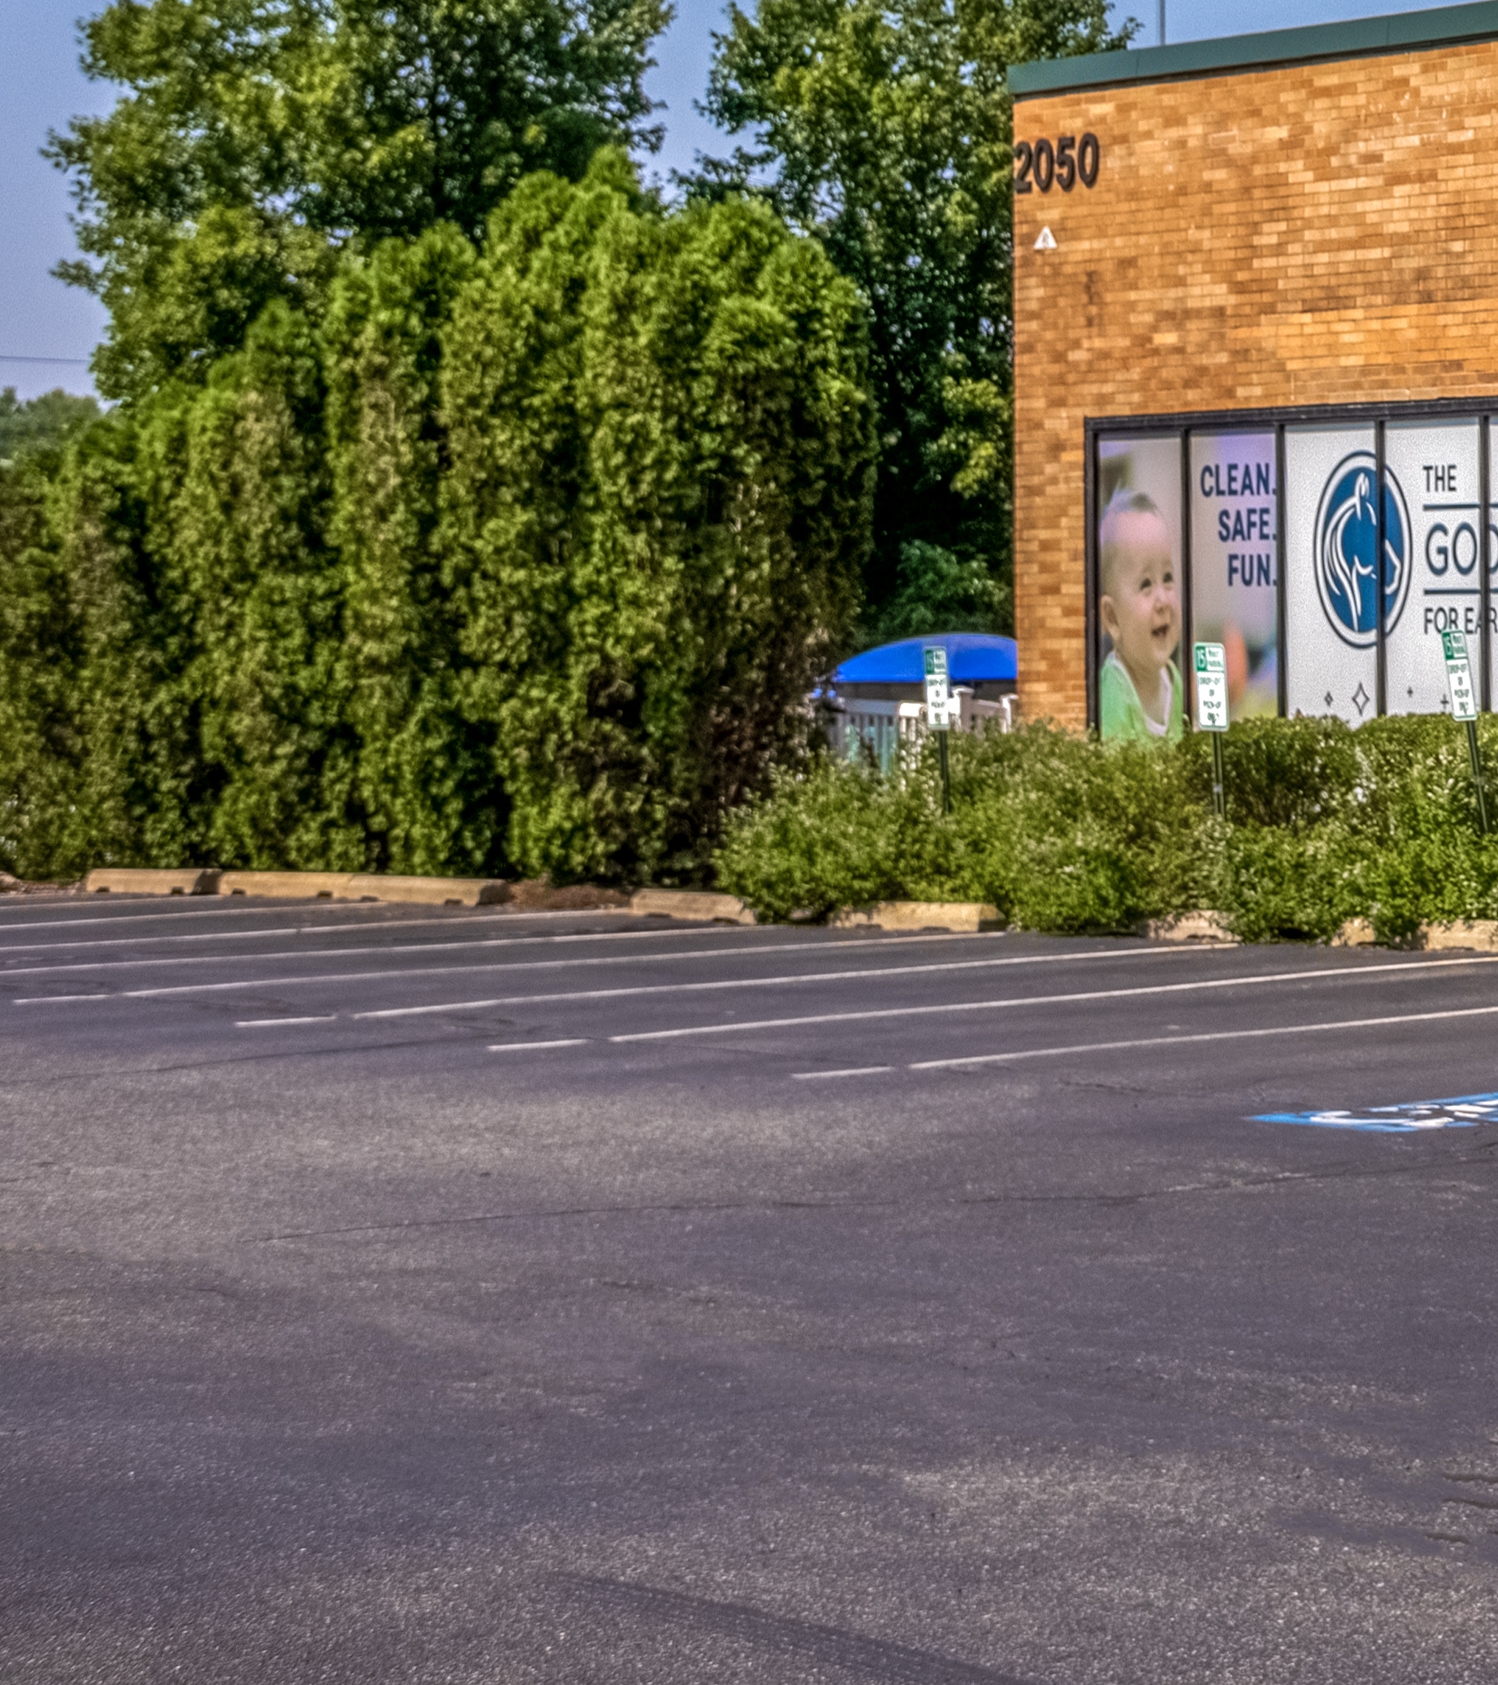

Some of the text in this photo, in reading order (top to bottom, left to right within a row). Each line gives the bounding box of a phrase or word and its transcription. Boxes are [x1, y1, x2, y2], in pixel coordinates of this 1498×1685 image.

[1013, 132, 1100, 194] 2050
[1200, 463, 1276, 497] CLEAN.
[1422, 464, 1457, 492] THE
[1218, 508, 1277, 542] SAFE.
[1228, 554, 1277, 587] FUN.
[1424, 606, 1459, 634] FOR
